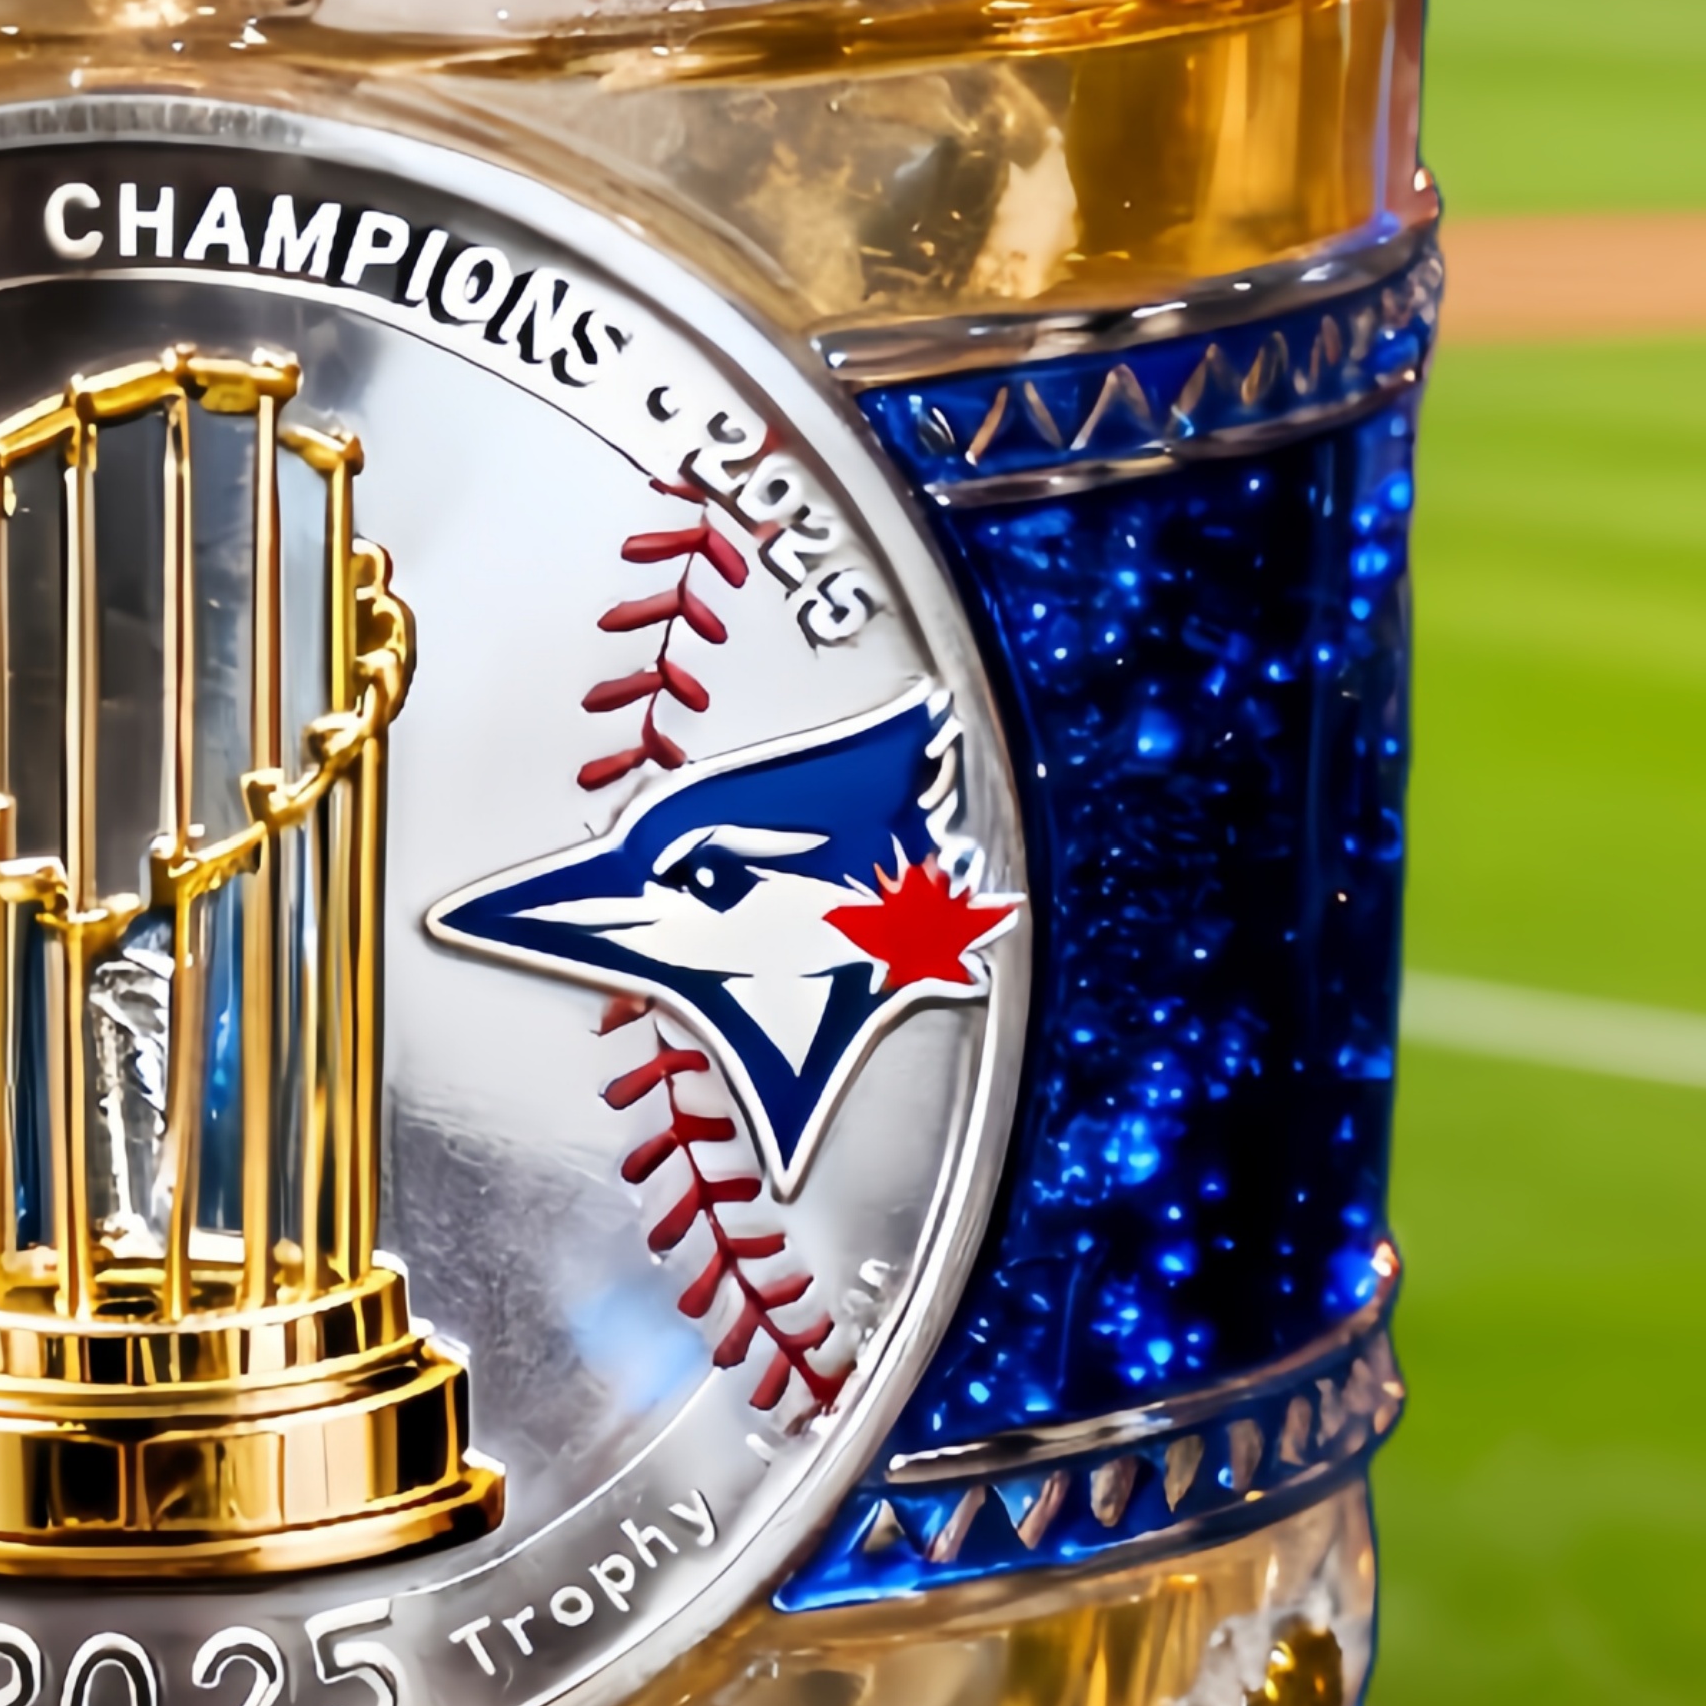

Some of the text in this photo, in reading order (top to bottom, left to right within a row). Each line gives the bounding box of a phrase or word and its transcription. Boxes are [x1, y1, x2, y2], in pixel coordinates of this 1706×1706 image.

[41, 180, 631, 388] CHAMPIONS
[677, 409, 879, 649] 2025
[447, 1487, 719, 1677] Trophy
